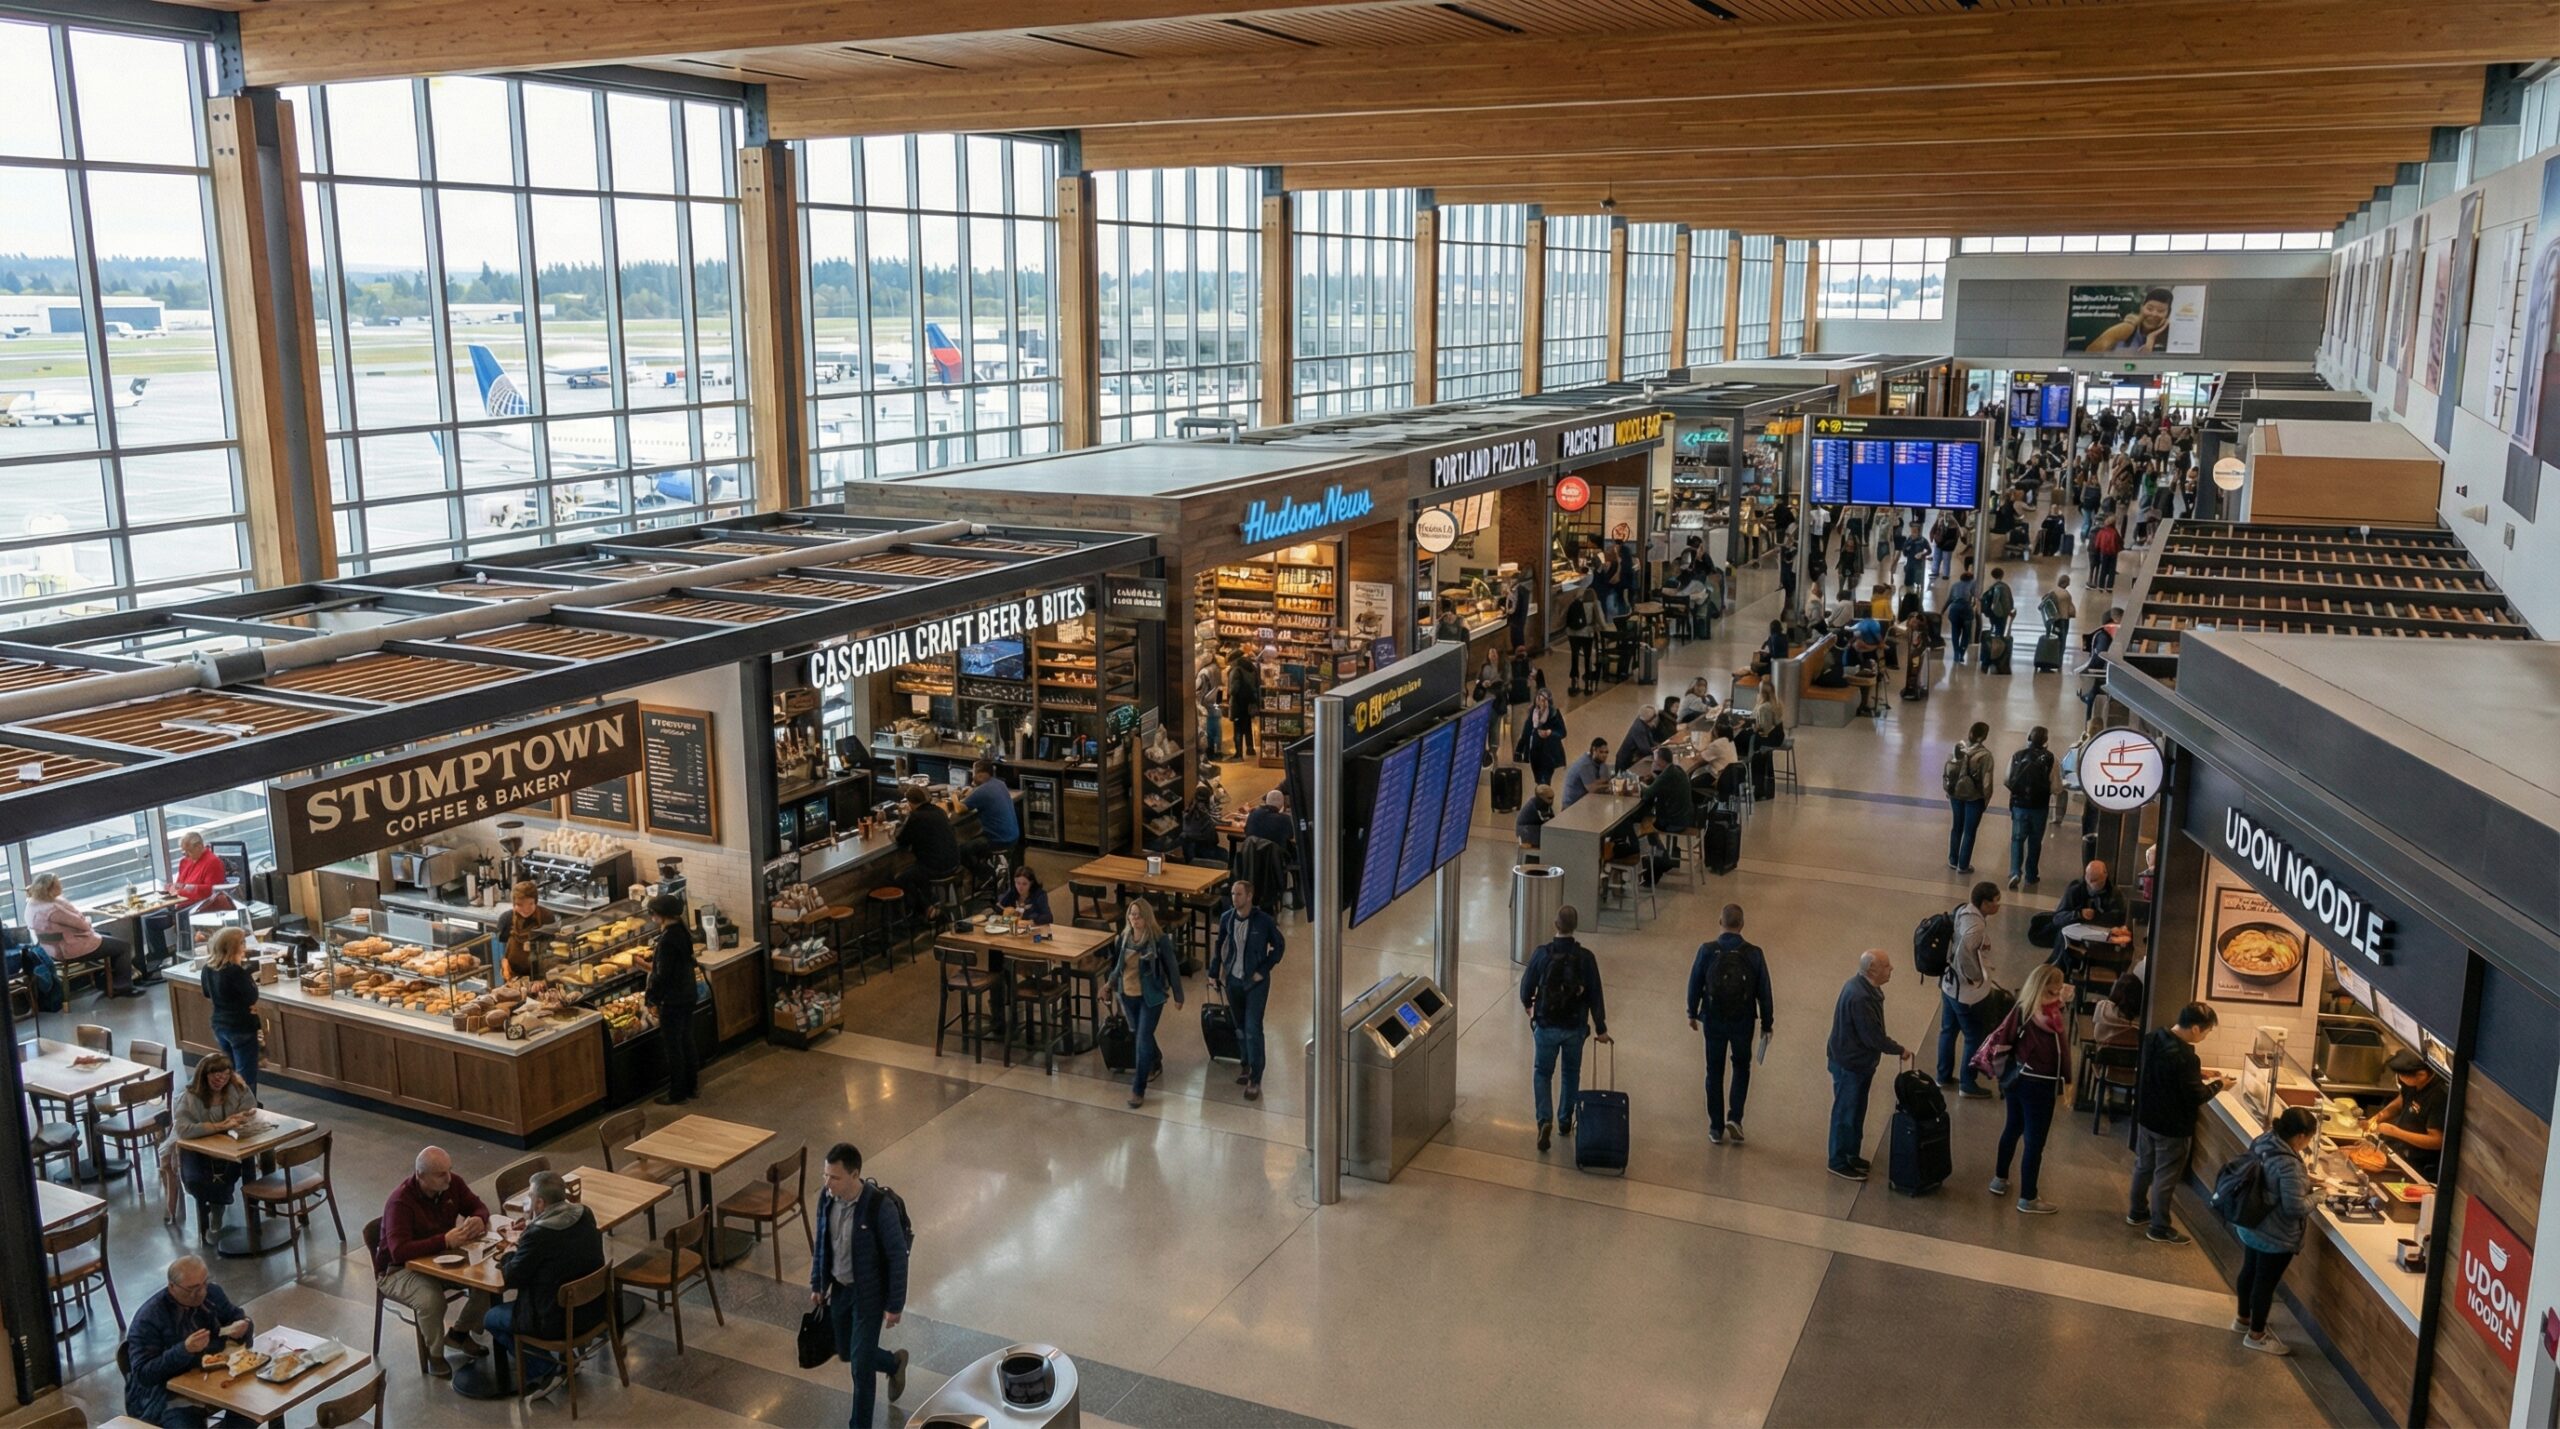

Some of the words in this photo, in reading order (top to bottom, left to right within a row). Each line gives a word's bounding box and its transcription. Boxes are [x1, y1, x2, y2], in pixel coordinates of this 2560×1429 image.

[1435, 447, 1491, 488] PORTLAND
[1492, 441, 1521, 475] PIZZA
[1523, 438, 1539, 468] CO.
[1564, 427, 1598, 457] PACIFIC
[1243, 495, 1324, 545] Hudson
[1322, 484, 1374, 526] News
[810, 633, 911, 689] CASCADIA
[915, 613, 974, 661] CRAFT
[978, 602, 1022, 644] BEER
[1025, 597, 1039, 630] &
[1042, 586, 1086, 625] BITES
[306, 713, 626, 834] STUMPTOWN
[385, 803, 468, 837] COFFEE
[475, 793, 488, 812] &
[495, 769, 572, 805] BAKERY
[2094, 784, 2145, 798] UDON
[2226, 806, 2281, 883] UDON
[2286, 852, 2384, 964] NOODLE
[2465, 1250, 2521, 1330] UDON
